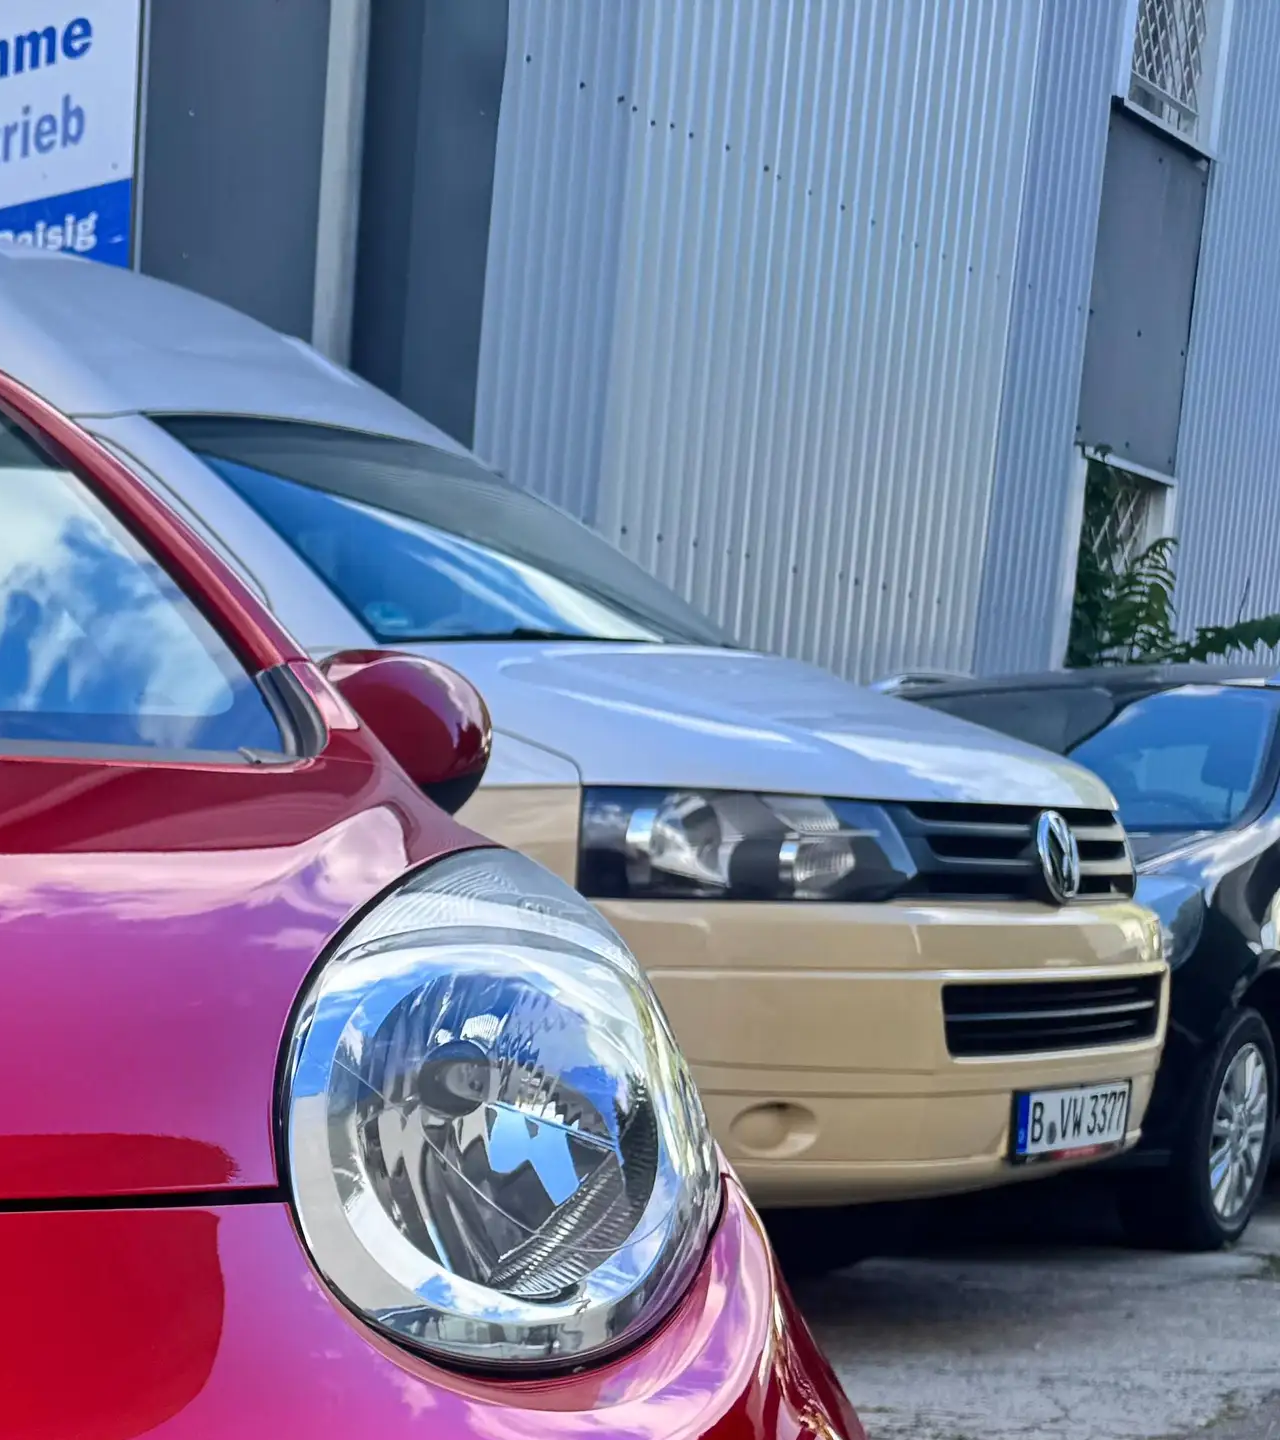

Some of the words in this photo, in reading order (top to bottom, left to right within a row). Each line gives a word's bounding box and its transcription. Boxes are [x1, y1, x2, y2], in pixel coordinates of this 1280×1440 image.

[1030, 1101, 1045, 1144] B
[1060, 1096, 1085, 1140] VW
[1086, 1089, 1127, 1136] 3377
